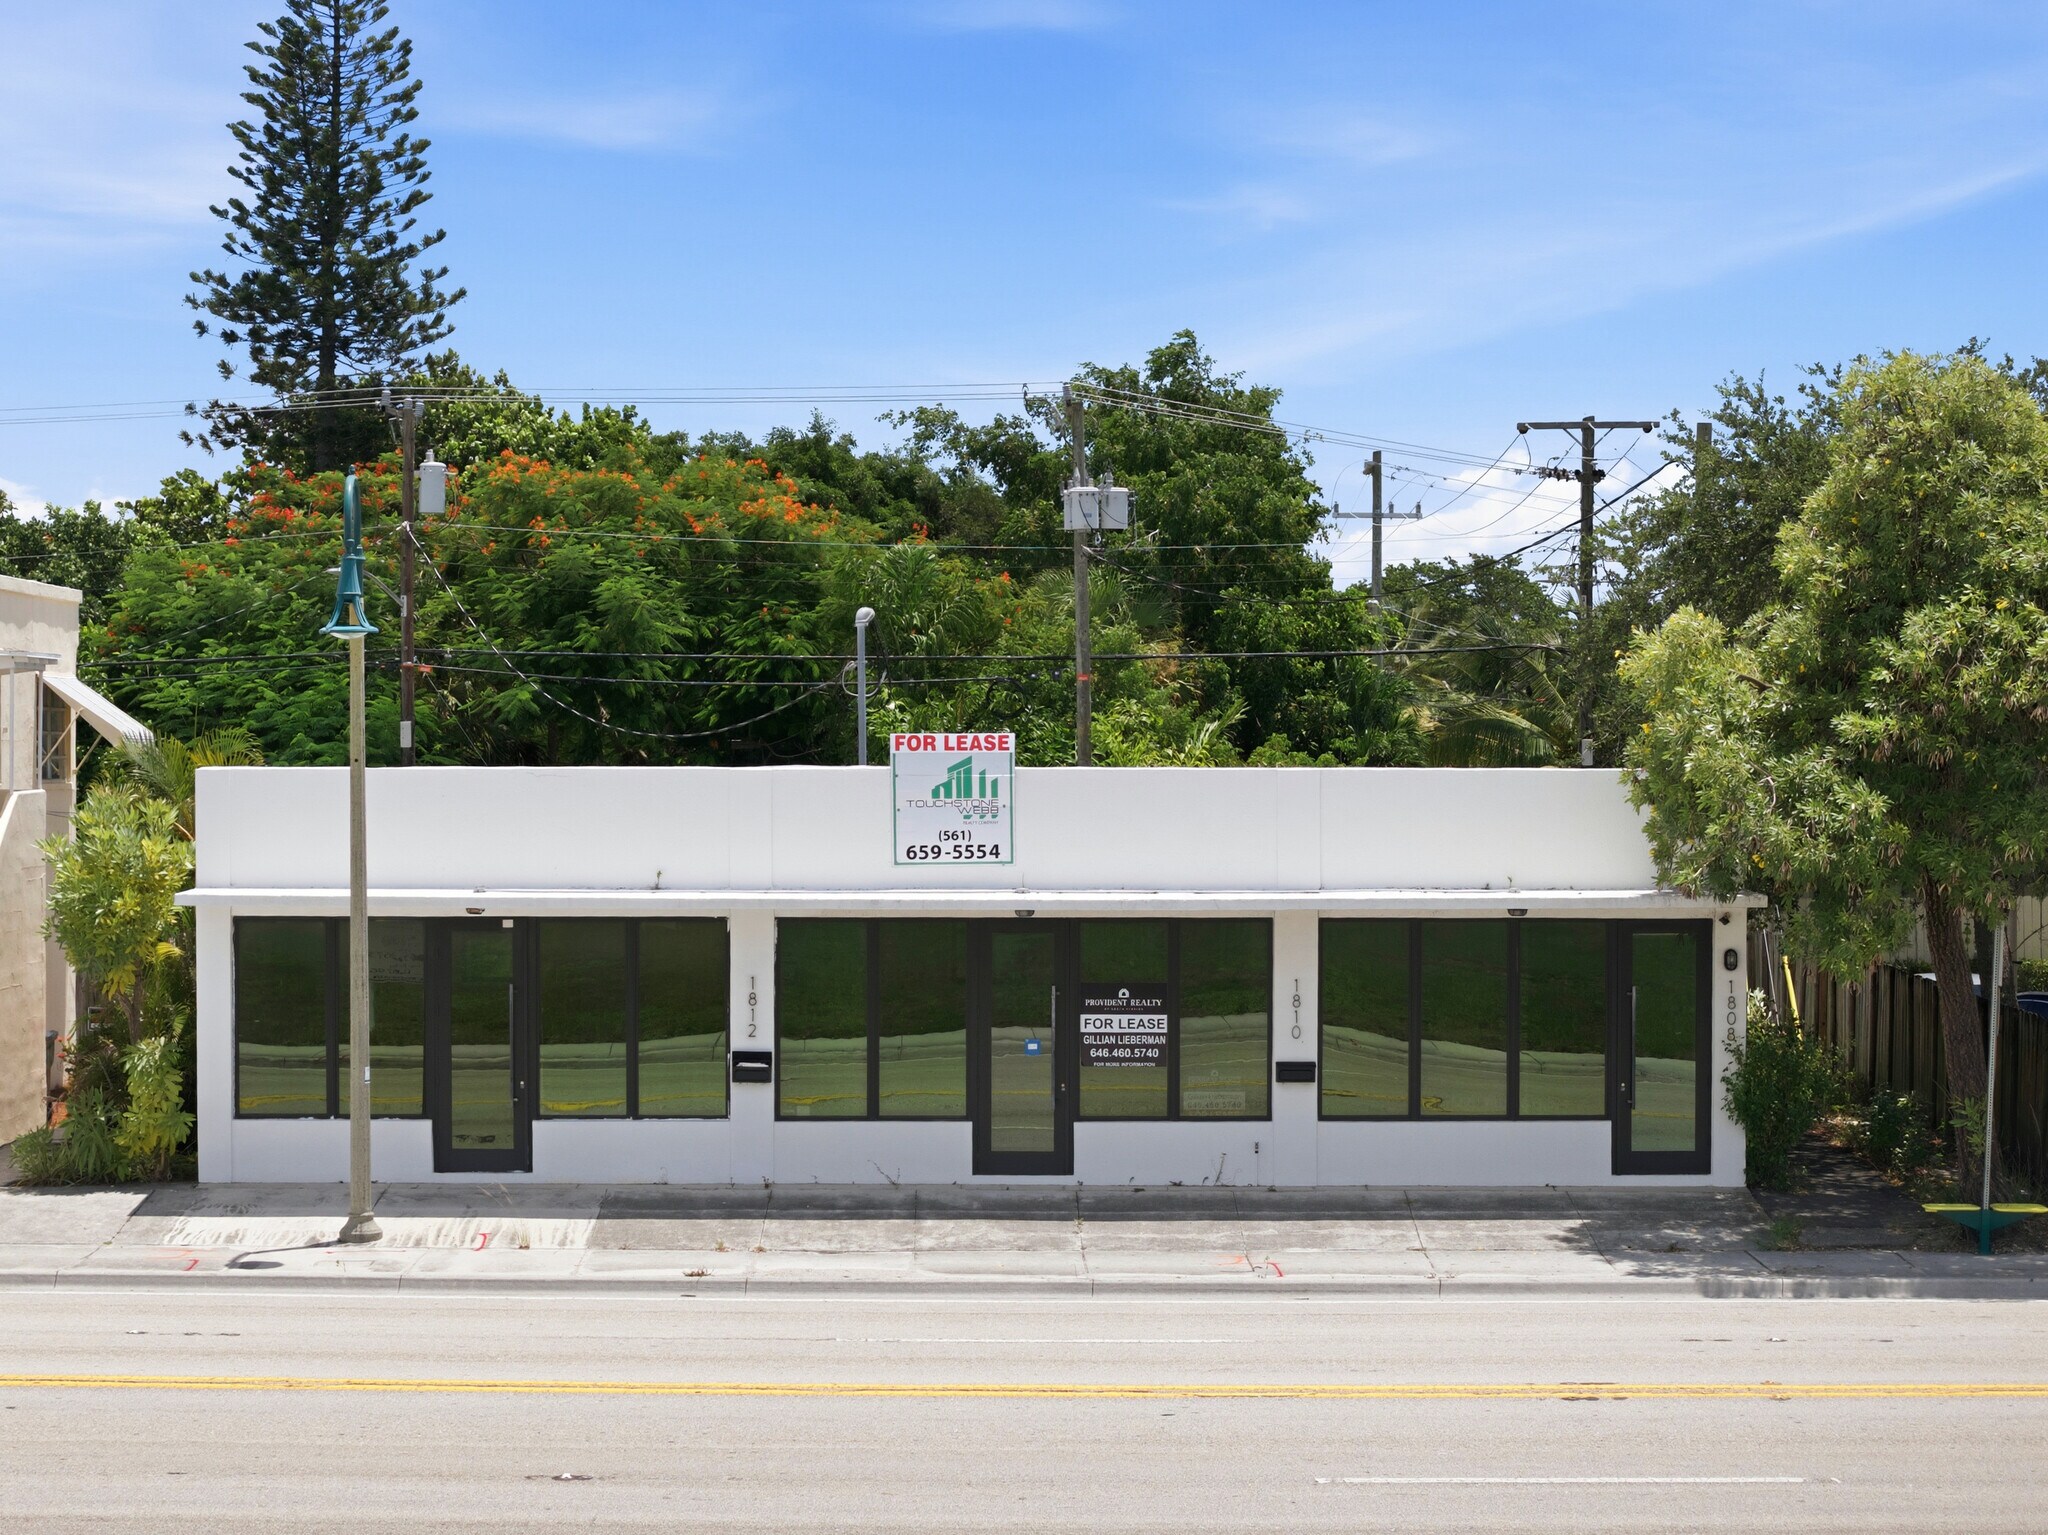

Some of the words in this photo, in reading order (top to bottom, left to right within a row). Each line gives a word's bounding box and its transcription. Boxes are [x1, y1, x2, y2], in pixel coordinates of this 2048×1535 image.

[895, 735, 936, 751] FOR
[944, 735, 1010, 751] LEASE
[906, 799, 999, 808] TOUCHSTONE
[938, 830, 971, 842] (561)
[906, 844, 1000, 860] 659-5554
[748, 976, 757, 1038] 1812
[1291, 979, 1301, 1039] 1810
[1726, 980, 1736, 1041] 1808
[1084, 1018, 1113, 1029] FOR
[1118, 1018, 1165, 1029] LEASE
[1083, 1035, 1116, 1044] GILLIAN
[1117, 1035, 1166, 1044] LIEBERMAN
[1090, 1048, 1159, 1057] 646.460.5740
